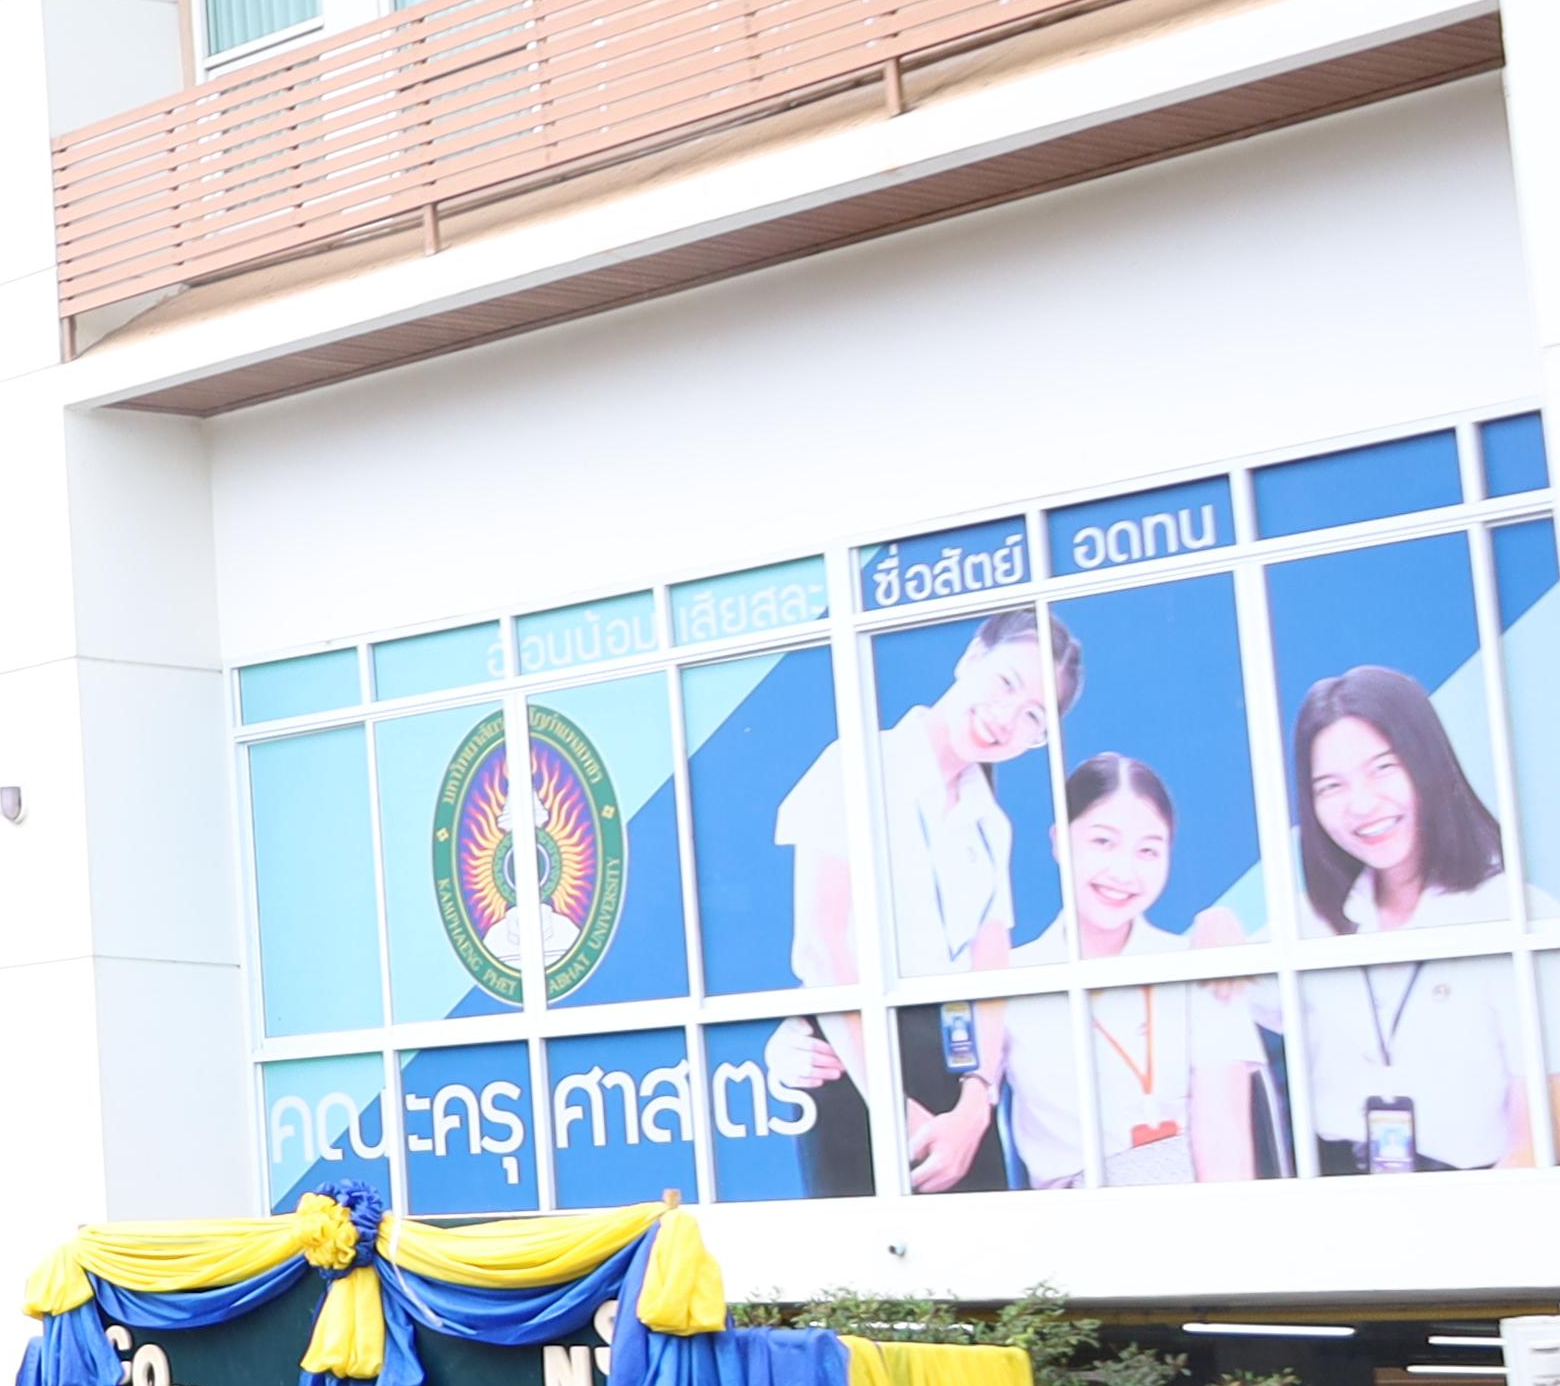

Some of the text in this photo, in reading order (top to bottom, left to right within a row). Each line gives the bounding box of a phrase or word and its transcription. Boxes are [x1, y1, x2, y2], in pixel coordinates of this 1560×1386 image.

[872, 533, 1028, 606] ซื่อสัตย์
[1071, 502, 1216, 570] อดทน
[482, 969, 518, 996] PHET
[590, 856, 621, 951] UNIVERSITY
[270, 1059, 818, 1184] คณะครุศาสตร
